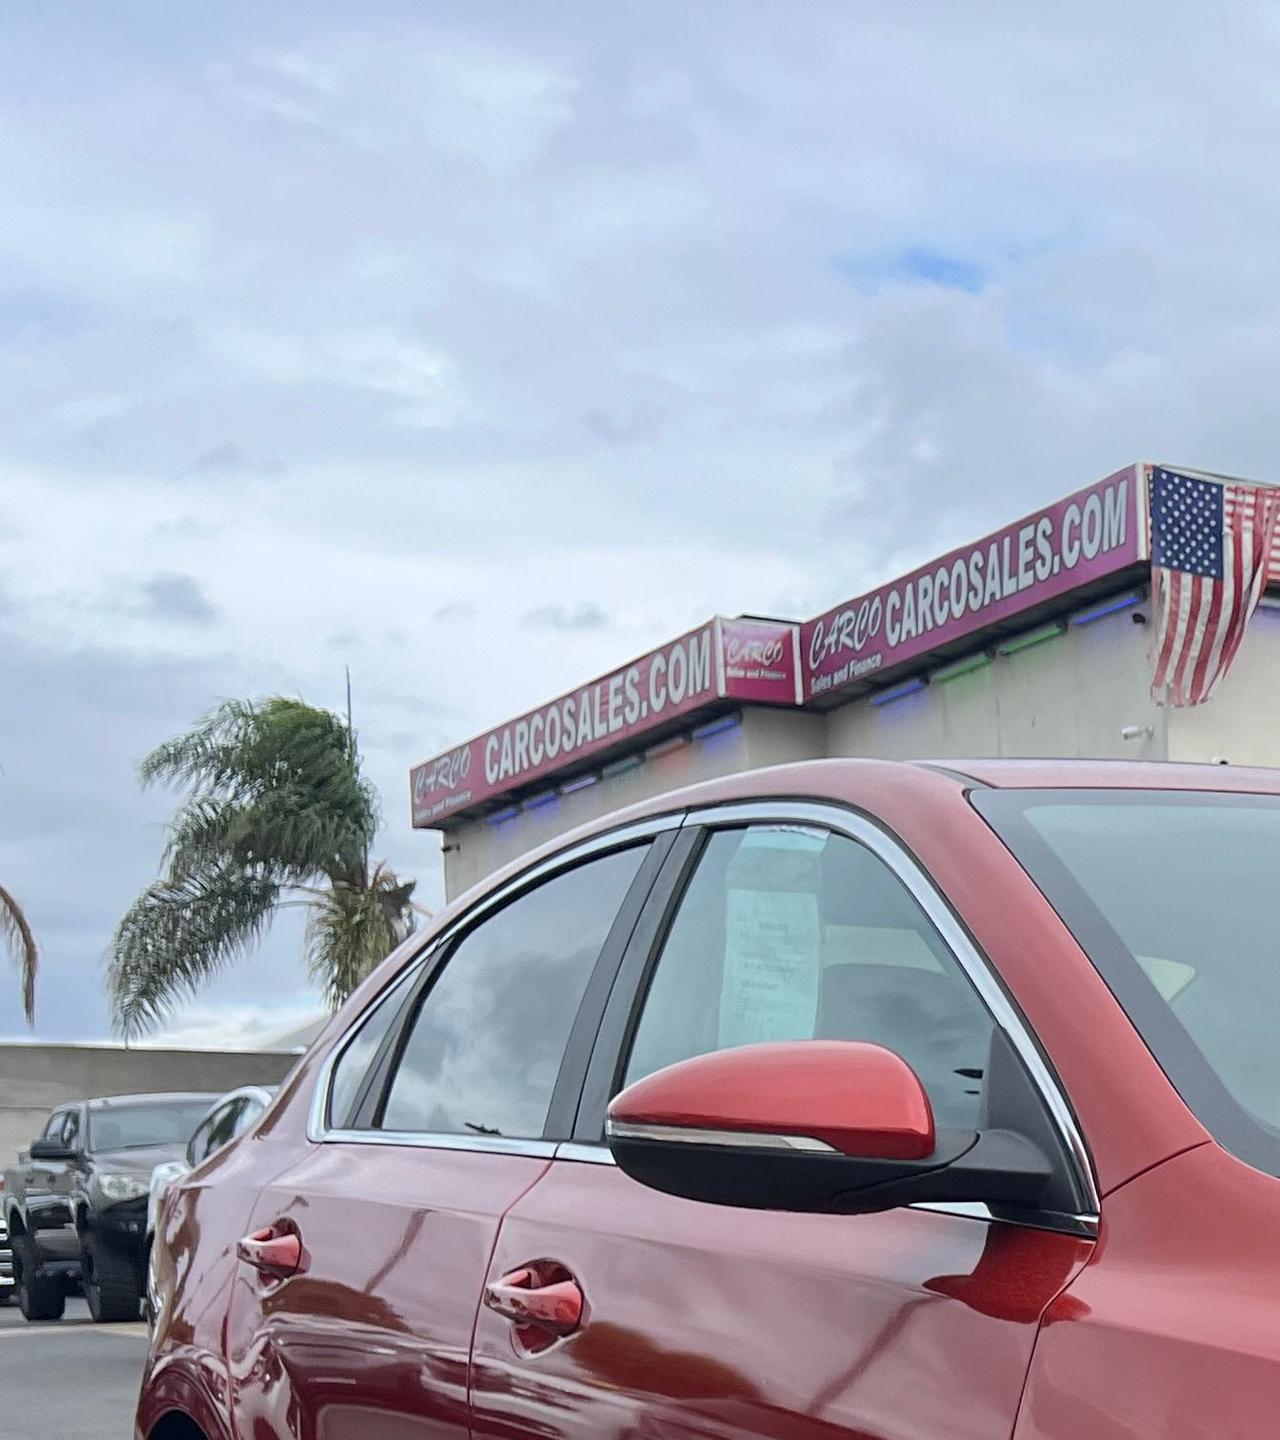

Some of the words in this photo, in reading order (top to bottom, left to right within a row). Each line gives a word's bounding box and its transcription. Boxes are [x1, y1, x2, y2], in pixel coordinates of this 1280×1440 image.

[885, 480, 1128, 648] CARCOSALES.COM
[726, 638, 784, 667] CARCO
[808, 595, 883, 671] CARCO
[484, 629, 712, 786] CARCOSALES.COM
